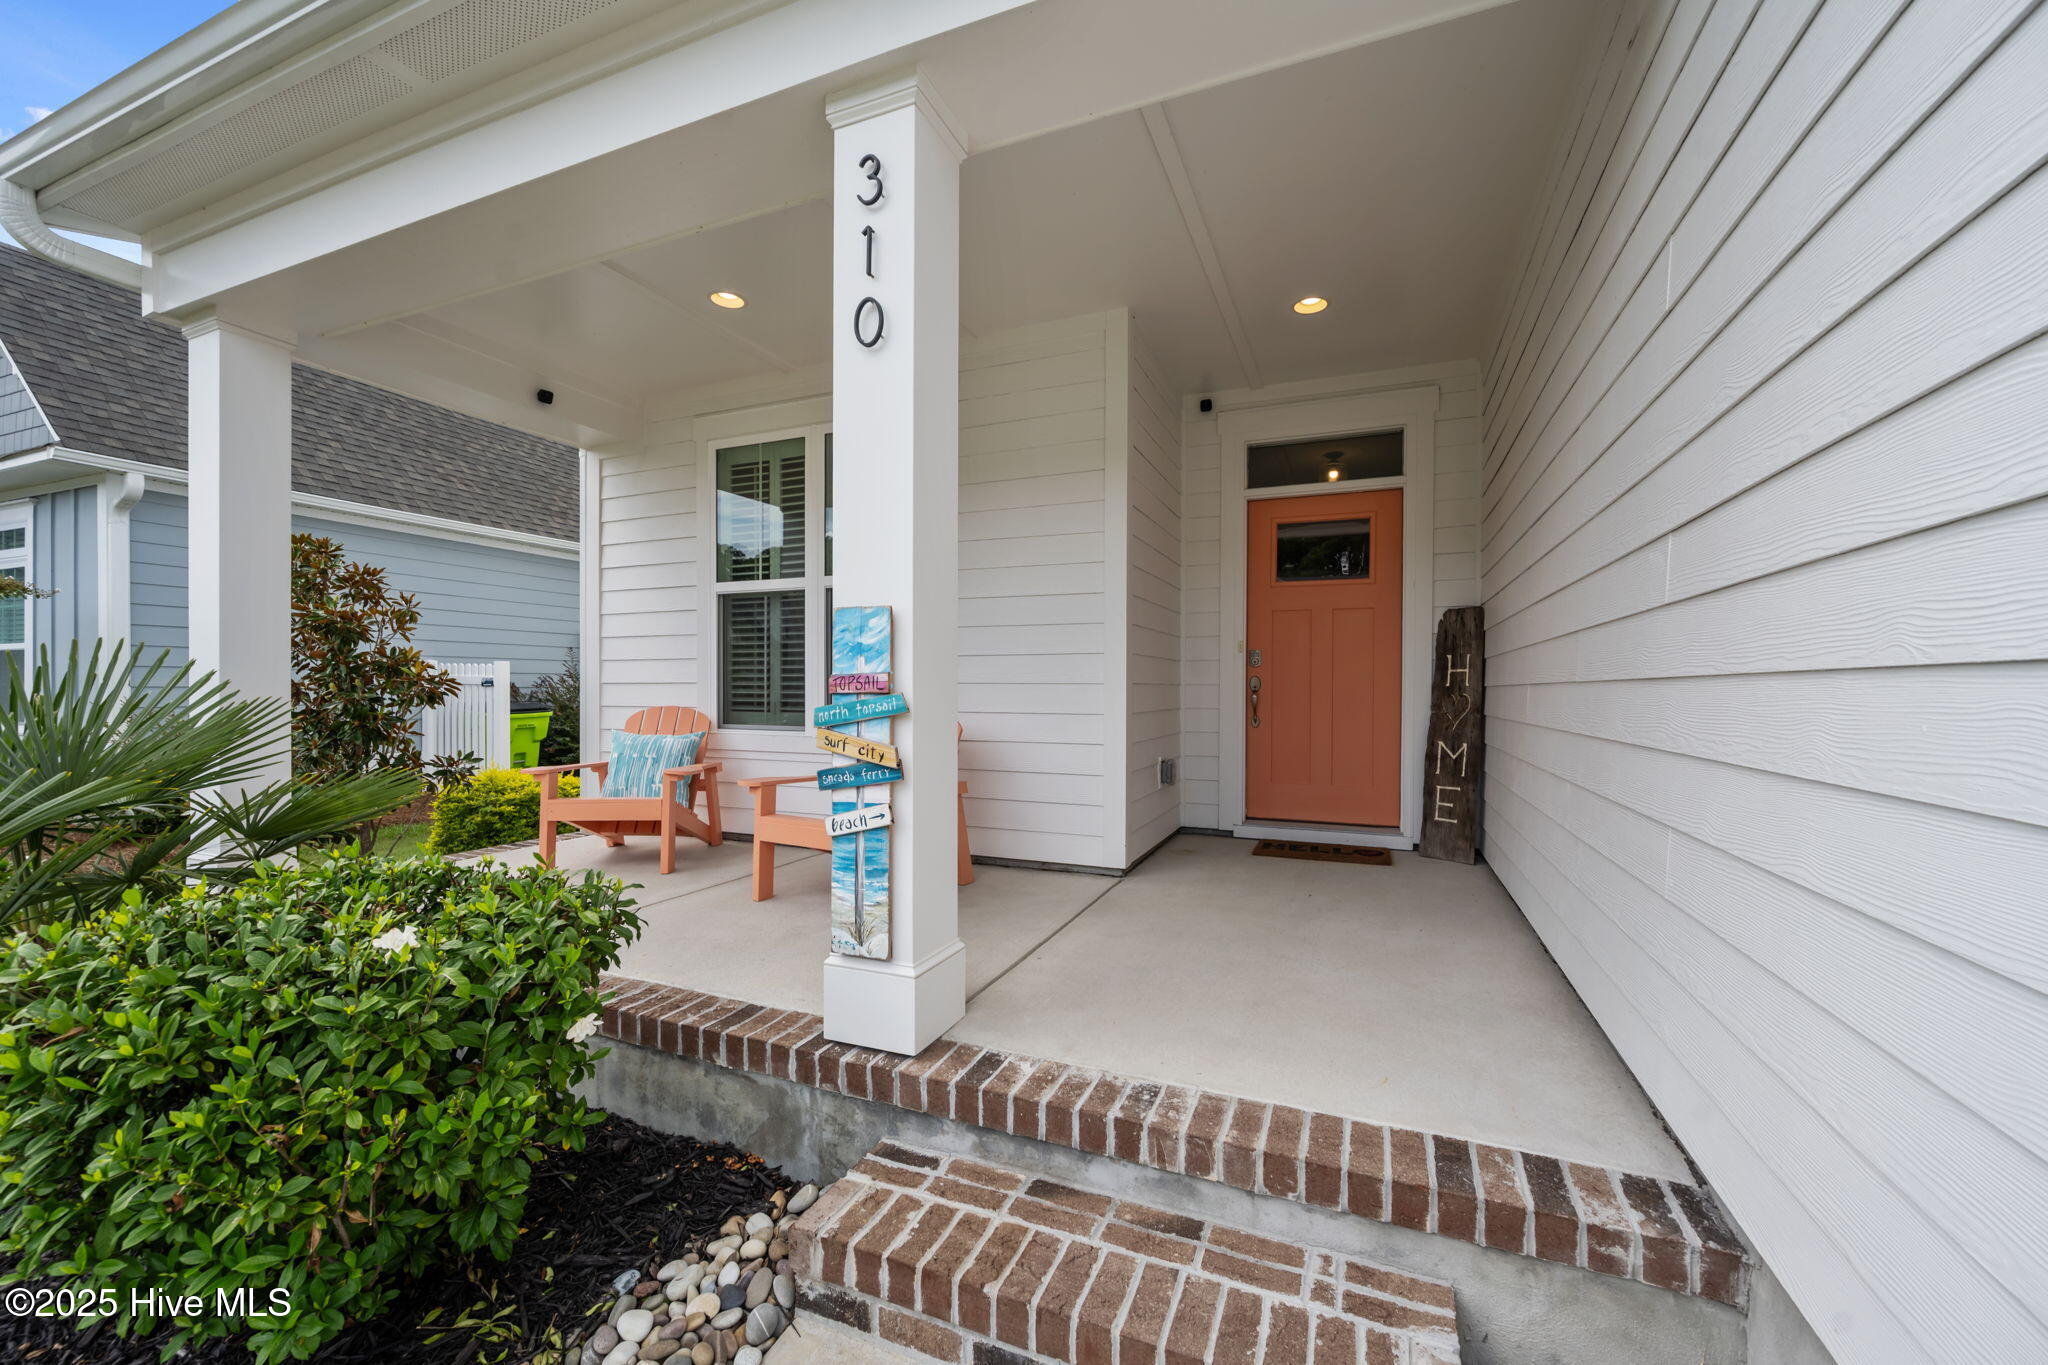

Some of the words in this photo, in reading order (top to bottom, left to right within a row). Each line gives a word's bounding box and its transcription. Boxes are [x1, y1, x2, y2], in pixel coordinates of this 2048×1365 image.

[854, 154, 884, 347] 310
[833, 675, 885, 693] TOPSAIL
[818, 706, 849, 723] north
[856, 697, 897, 717] topsail
[824, 735, 851, 752] surf
[858, 743, 885, 763] city
[822, 770, 855, 785] sneads
[861, 767, 891, 781] ferry
[831, 813, 868, 832] beach
